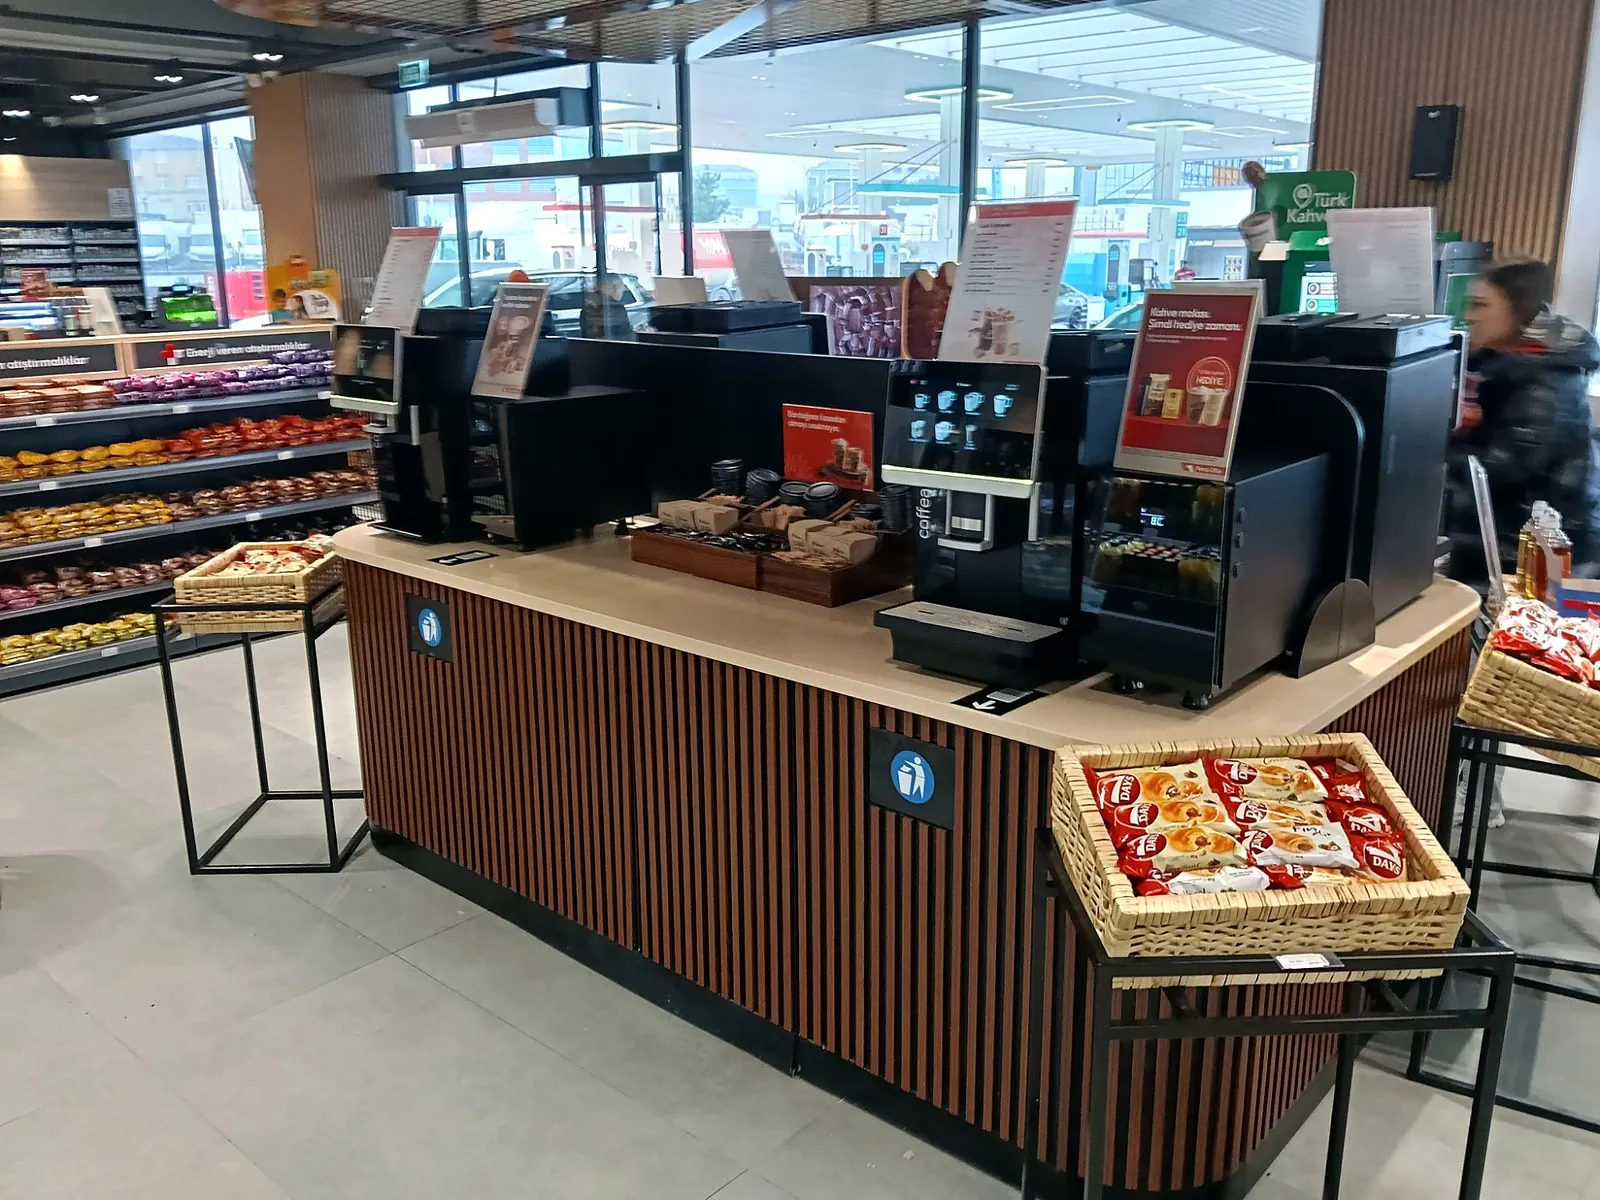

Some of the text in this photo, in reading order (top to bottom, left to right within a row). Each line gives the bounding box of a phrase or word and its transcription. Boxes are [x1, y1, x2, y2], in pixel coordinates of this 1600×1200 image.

[1313, 192, 1351, 208] Türk
[1150, 307, 1177, 317] Kahve
[1147, 319, 1172, 330] Şimdi
[1173, 319, 1204, 332] hediye
[186, 347, 215, 359] Enerji
[216, 346, 244, 355] veren
[7, 355, 88, 370] atıştırmalıklar
[1120, 775, 1135, 802] DAYS
[1373, 856, 1402, 875] DAYS
